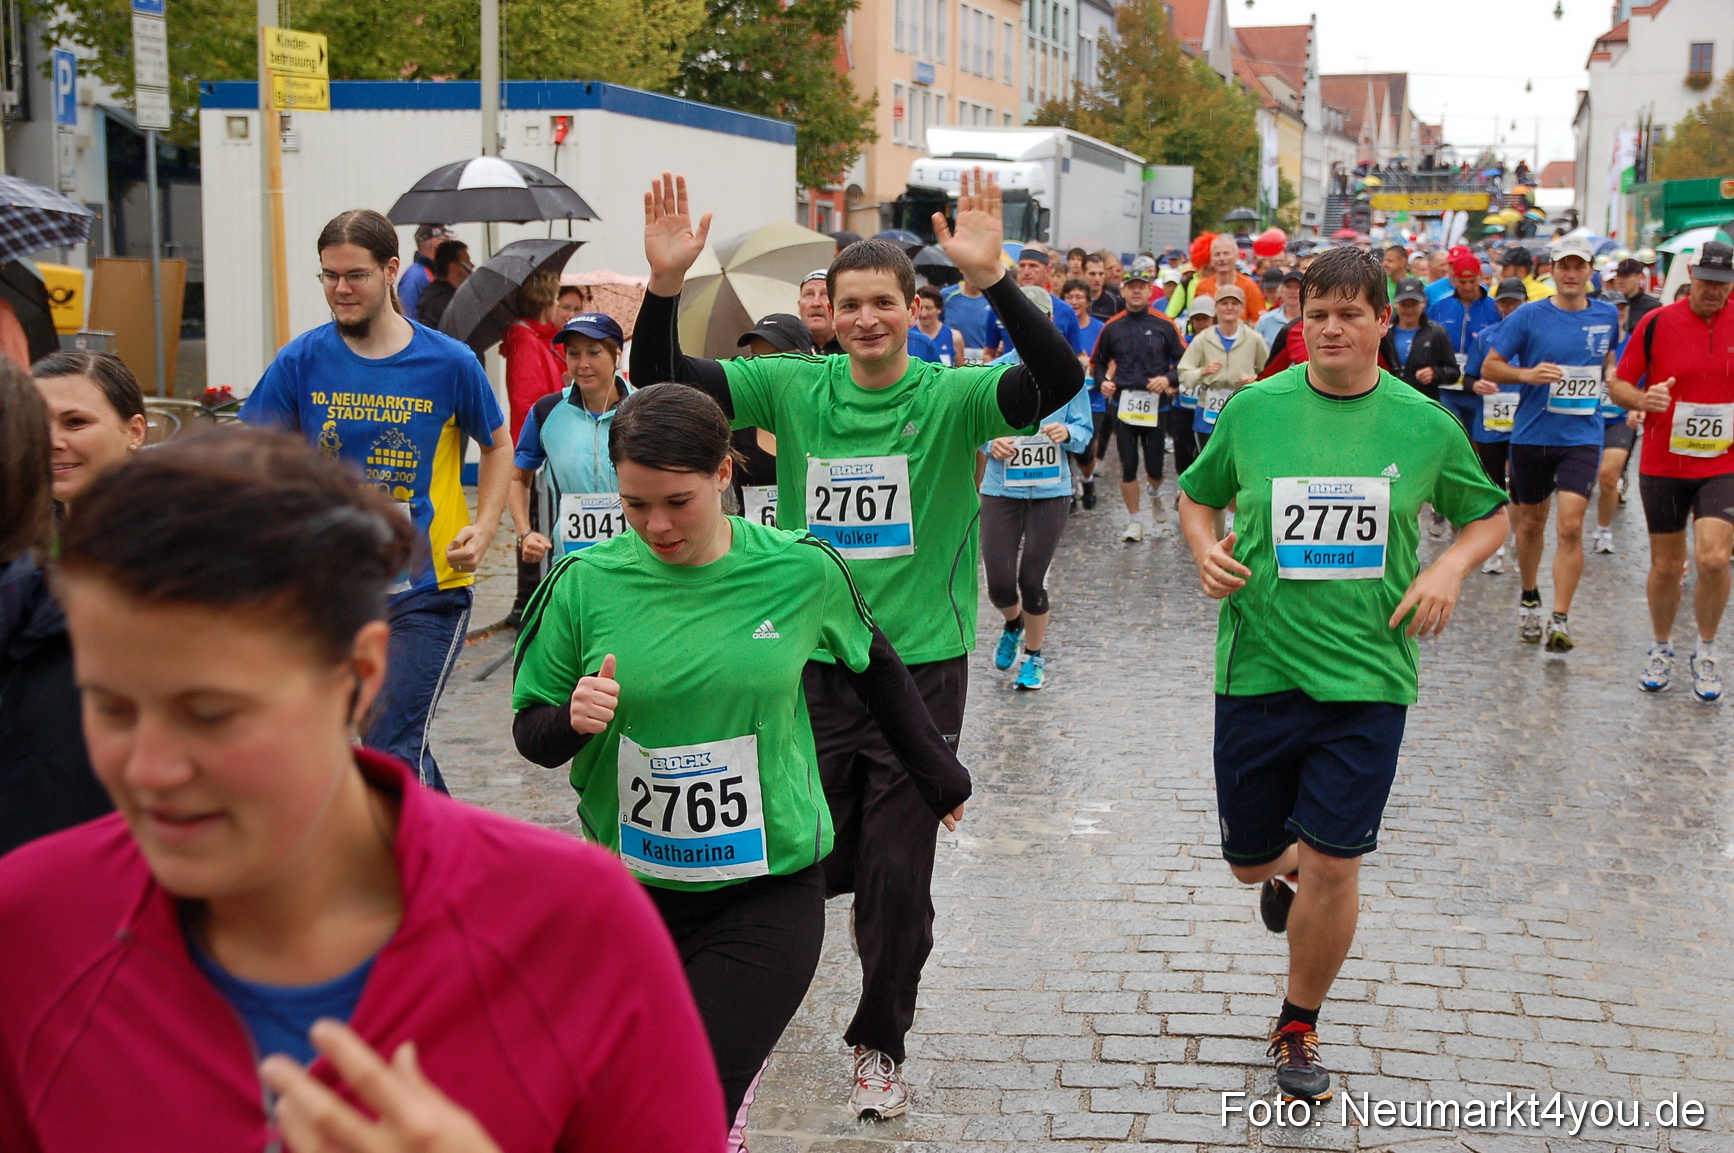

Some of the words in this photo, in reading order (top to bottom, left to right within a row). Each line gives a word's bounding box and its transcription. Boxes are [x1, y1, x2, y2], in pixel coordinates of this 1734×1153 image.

[277, 34, 310, 50] Kinder-
[270, 51, 316, 73] betreuung
[58, 59, 73, 116] P
[1408, 198, 1448, 206] START
[1556, 379, 1597, 397] 2922
[310, 392, 330, 405] 10.
[331, 392, 434, 413] NEUMARKTER
[1127, 399, 1150, 413] 546
[327, 406, 412, 424] STADTLAUF
[1685, 418, 1722, 437] 526
[1010, 446, 1056, 467] 2640
[830, 464, 873, 475] BOCK
[1308, 484, 1353, 494] BOCK
[815, 484, 898, 522] 2767
[568, 513, 626, 539] 3041
[1284, 505, 1377, 541] 2775
[835, 530, 879, 545] Volker
[1304, 550, 1354, 564] Konrad
[650, 752, 711, 770] BOCK
[631, 776, 748, 833] 2765
[642, 838, 735, 863] Katharina
